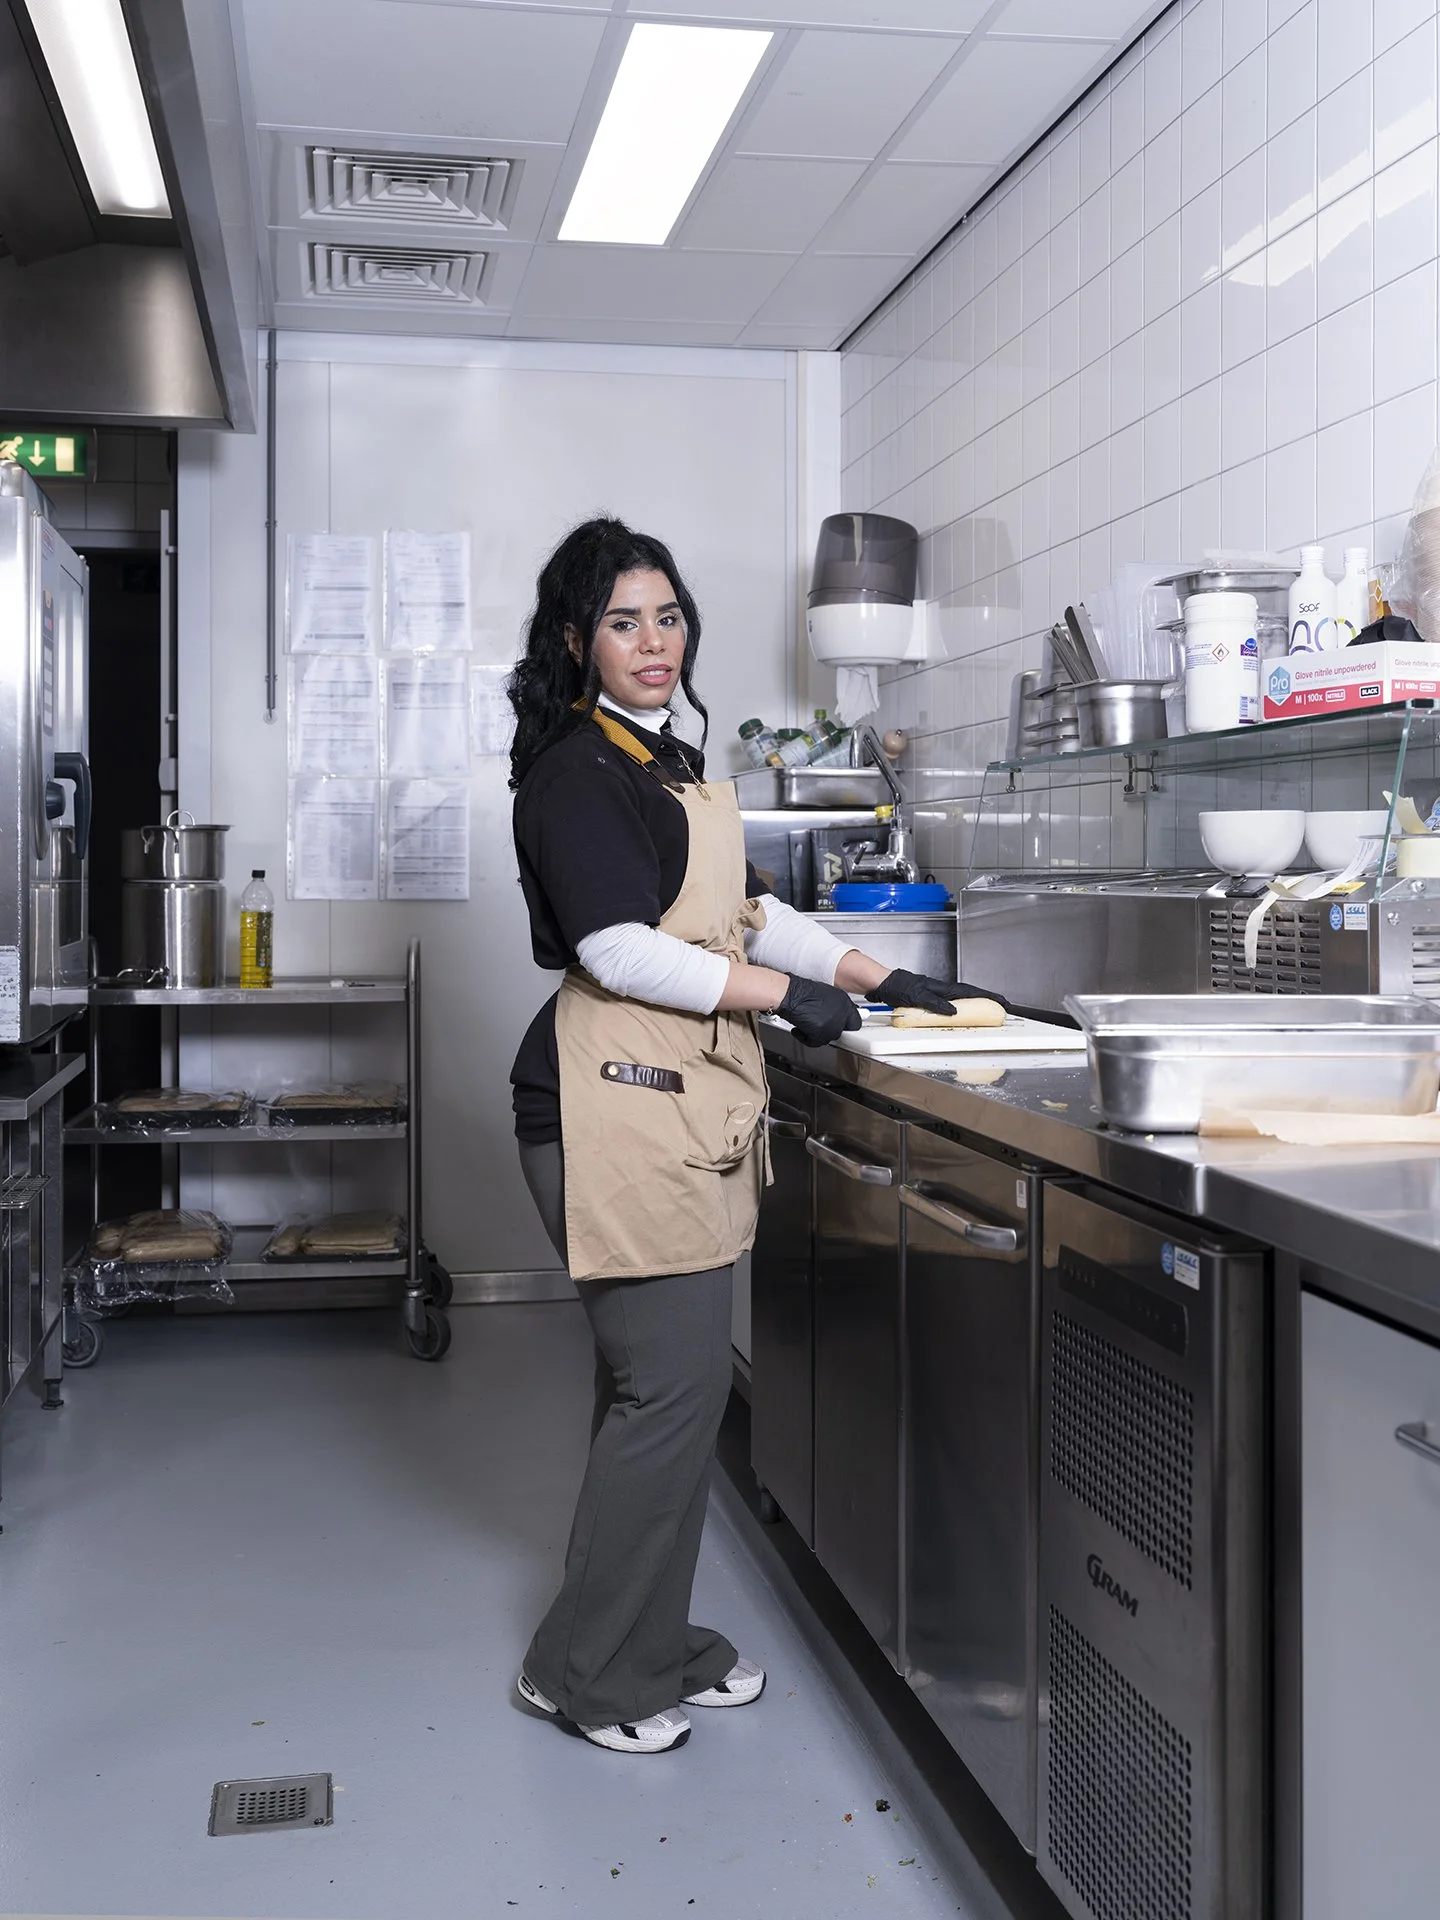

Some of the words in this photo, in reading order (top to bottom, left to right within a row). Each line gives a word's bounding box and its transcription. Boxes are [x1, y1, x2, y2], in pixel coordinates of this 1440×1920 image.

[1295, 671, 1313, 680] Glove
[1314, 668, 1333, 678] nitrile
[1334, 661, 1377, 675] unpowdered
[1295, 695, 1302, 704] M
[1307, 692, 1323, 703] 100x
[1361, 687, 1379, 696] BLACK
[1087, 1553, 1138, 1618] GRAM
